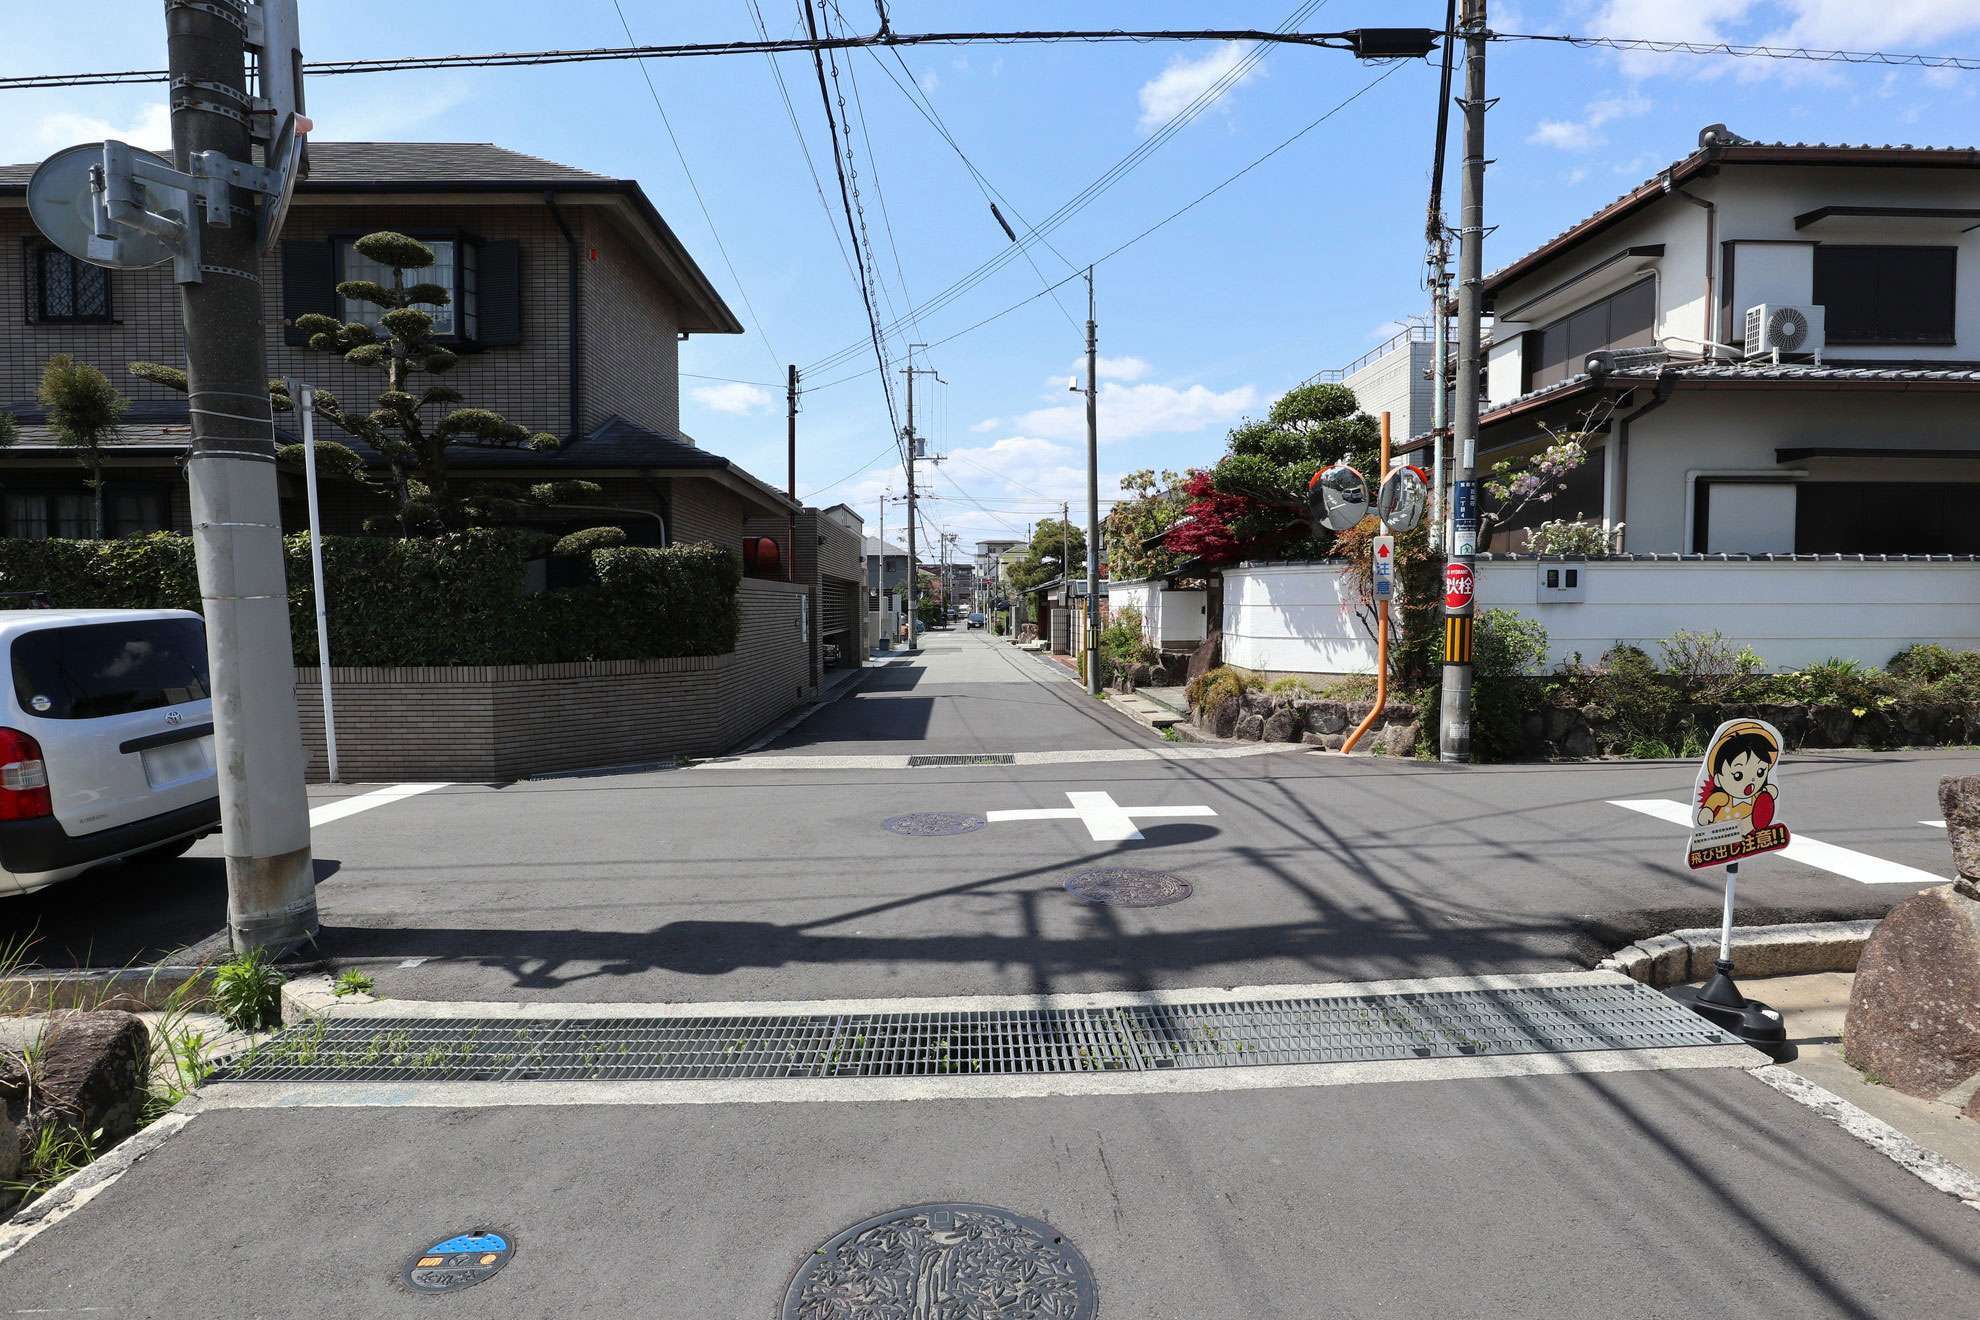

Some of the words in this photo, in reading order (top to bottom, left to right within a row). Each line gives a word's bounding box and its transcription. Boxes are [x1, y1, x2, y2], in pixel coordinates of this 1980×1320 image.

[1376, 561, 1391, 595] 注意
[1691, 827, 1786, 865] 飛び出し注意!!
